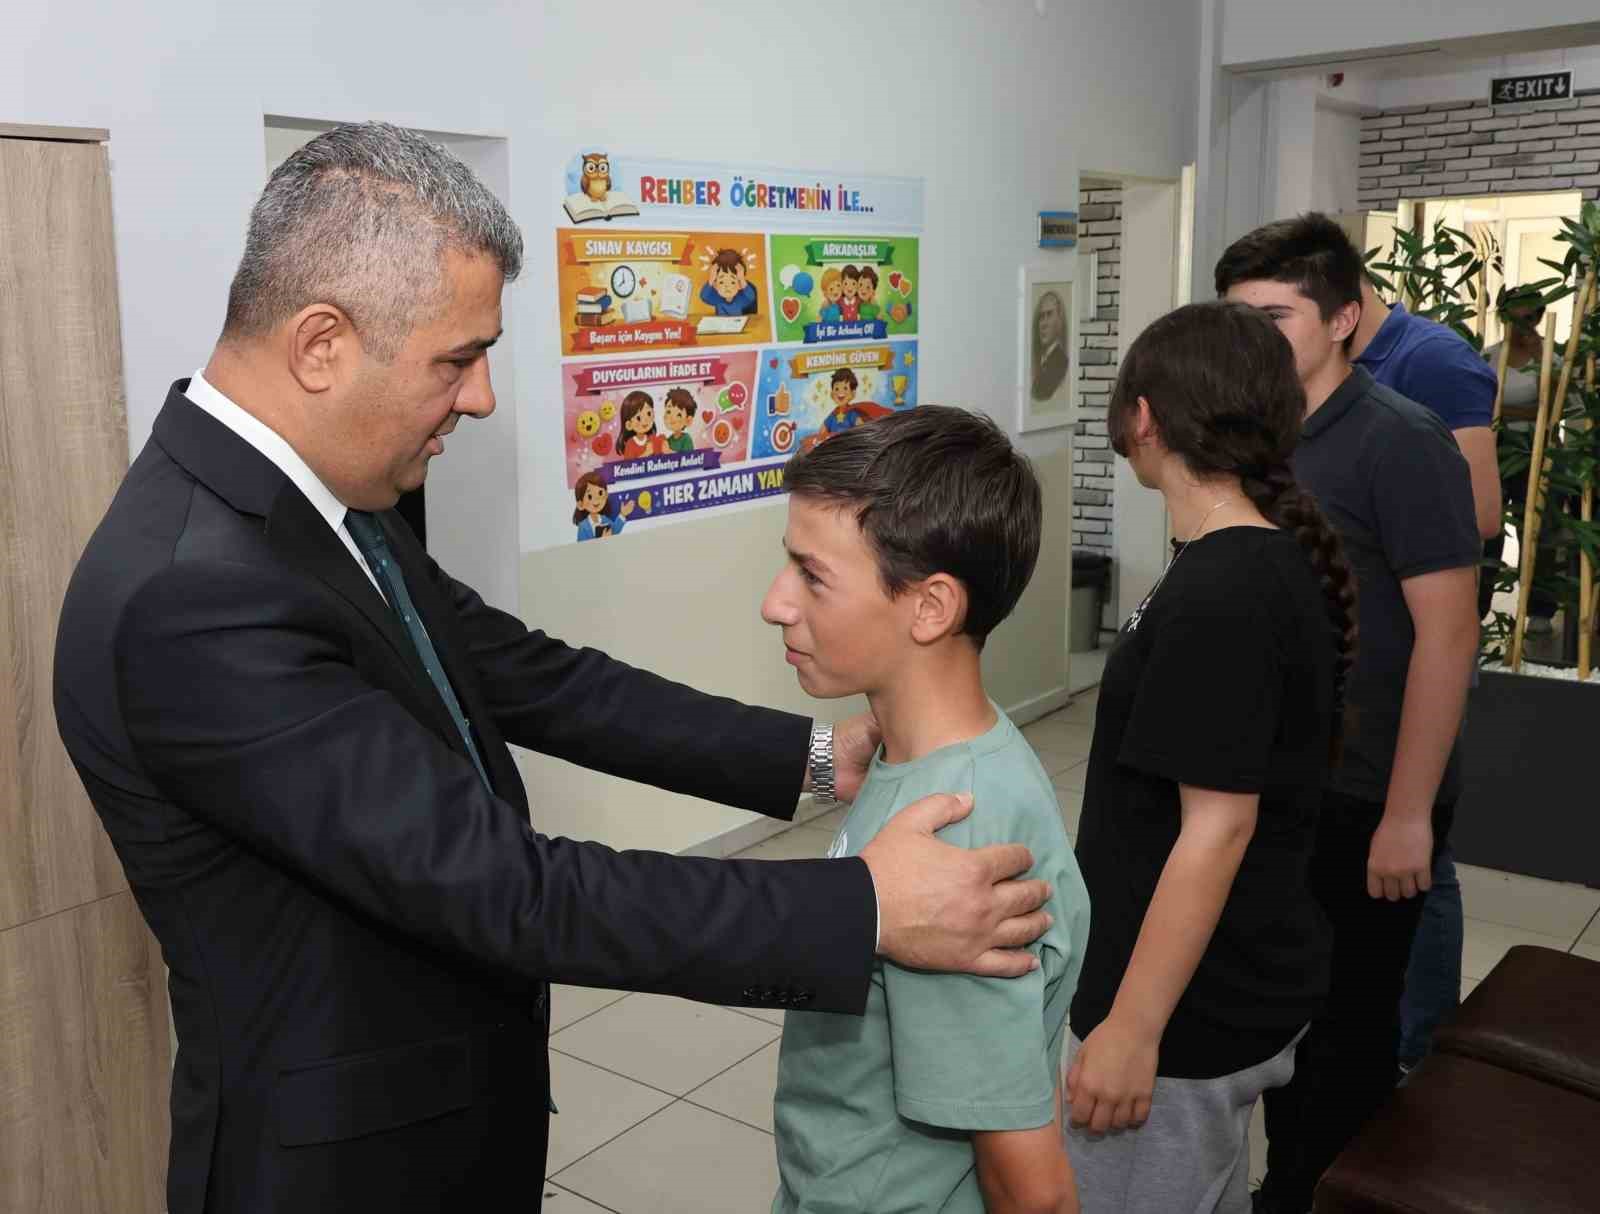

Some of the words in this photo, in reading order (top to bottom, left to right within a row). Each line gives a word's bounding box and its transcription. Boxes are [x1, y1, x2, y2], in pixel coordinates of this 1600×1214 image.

[1515, 78, 1554, 98] EXIT
[640, 176, 721, 206] REHBER
[730, 177, 831, 211] ÖĞRETMENİN
[838, 184, 874, 212] İLE...
[585, 240, 622, 256] SINAV
[823, 243, 877, 258] ARKADAŞLIK
[848, 351, 880, 364] GÜVEN
[592, 366, 667, 384] DUYGULARINI
[669, 362, 697, 377] İFADE
[700, 362, 711, 375] ET
[614, 462, 645, 477] Kendini
[647, 459, 679, 471] Rahatça
[680, 453, 704, 467] Anlat!
[663, 482, 695, 506] HER
[698, 473, 754, 500] ZAMAN
